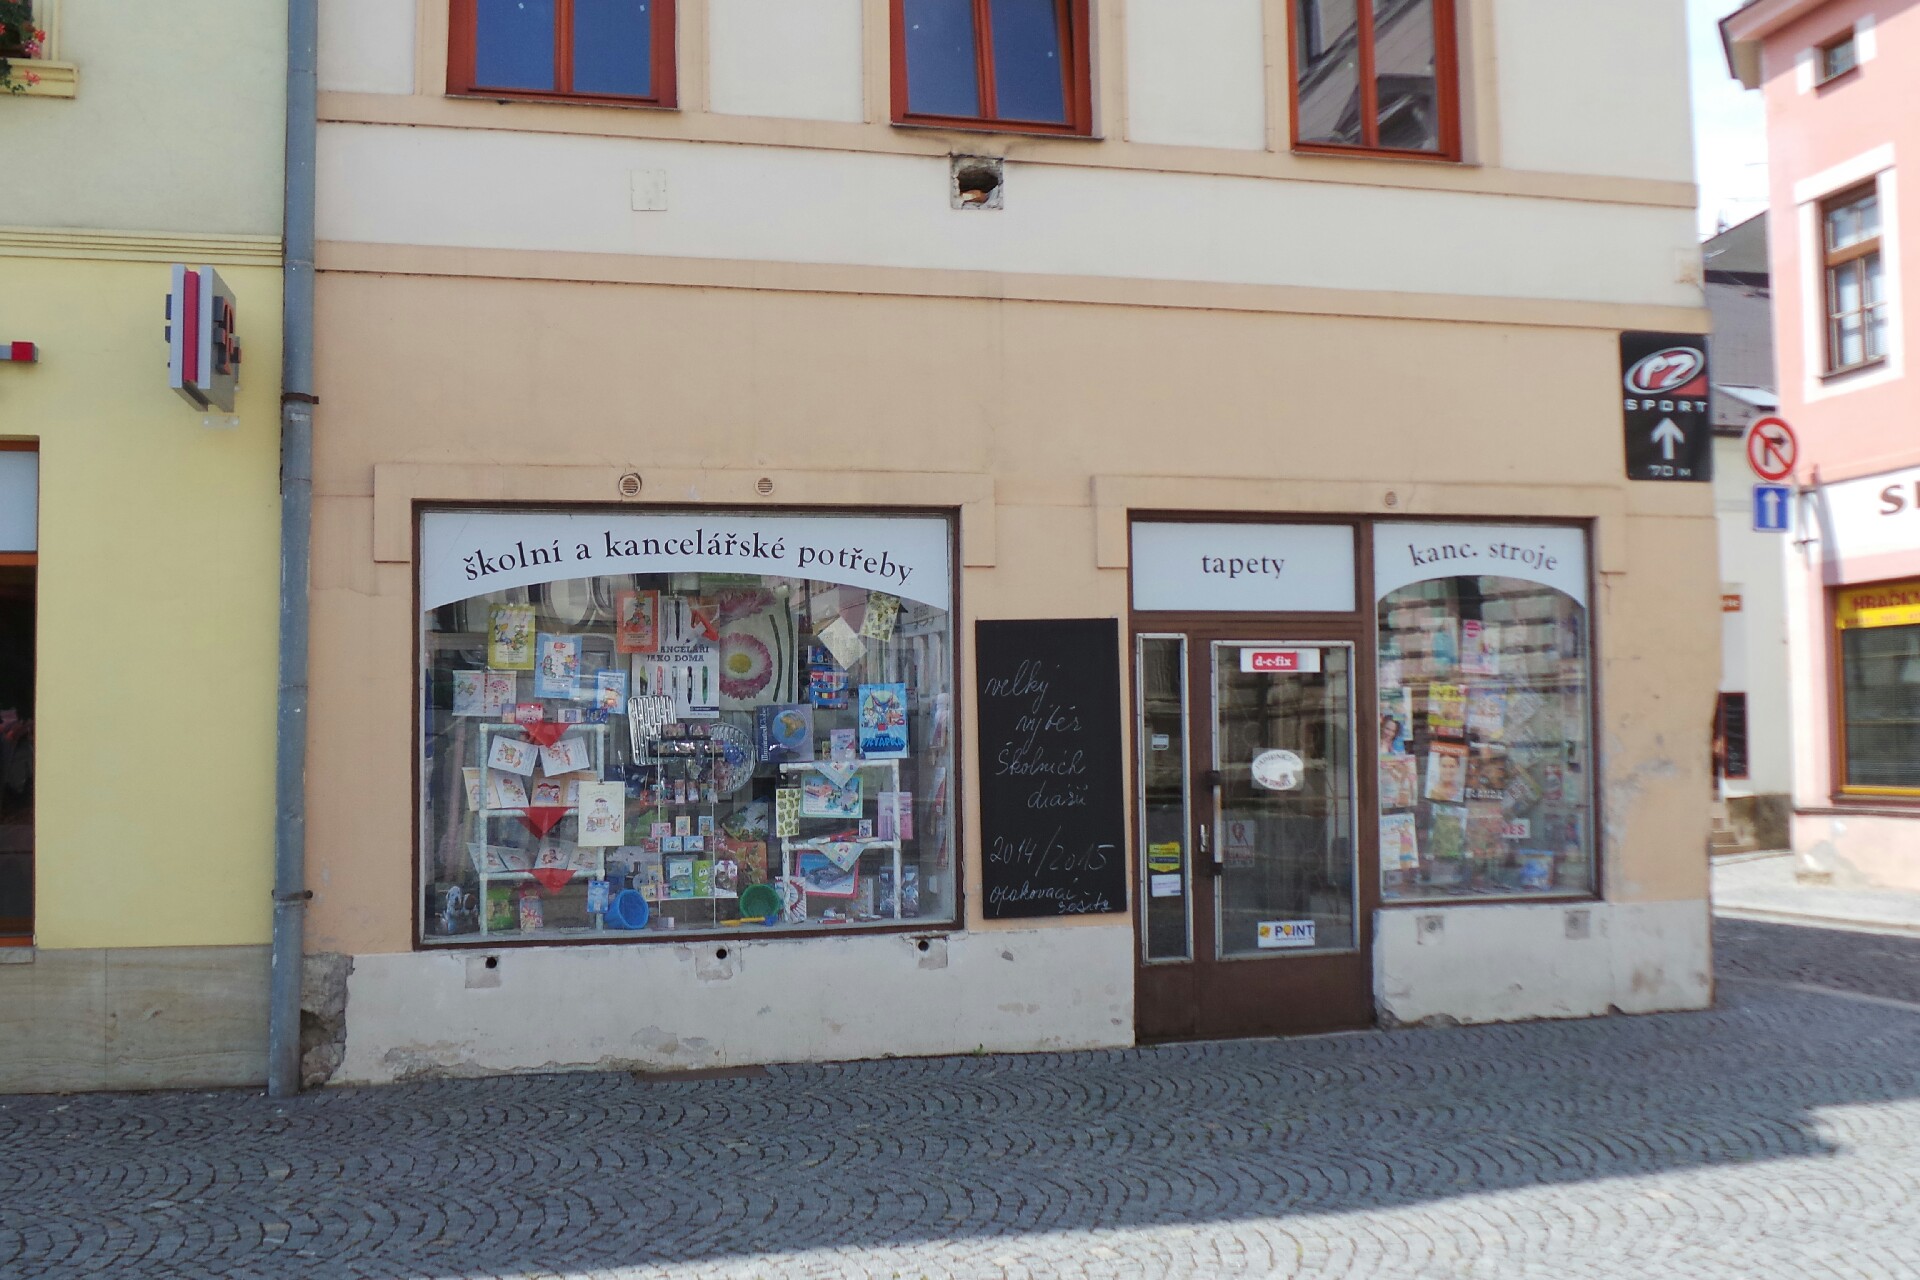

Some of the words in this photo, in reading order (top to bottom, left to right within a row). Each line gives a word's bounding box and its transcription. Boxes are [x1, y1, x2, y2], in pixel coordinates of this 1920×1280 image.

[1625, 399, 1708, 412] SPORT
[462, 540, 563, 580] školní
[575, 543, 592, 560] a
[604, 529, 785, 559] kancelářské
[798, 546, 913, 586] potřeby
[1202, 555, 1284, 579] tapety
[1408, 544, 1477, 567] kanc.
[1489, 542, 1558, 571] stroje
[1255, 655, 1291, 666] d-c-fix
[990, 825, 1115, 878] 2014/2015
[1274, 924, 1314, 937] POINT
